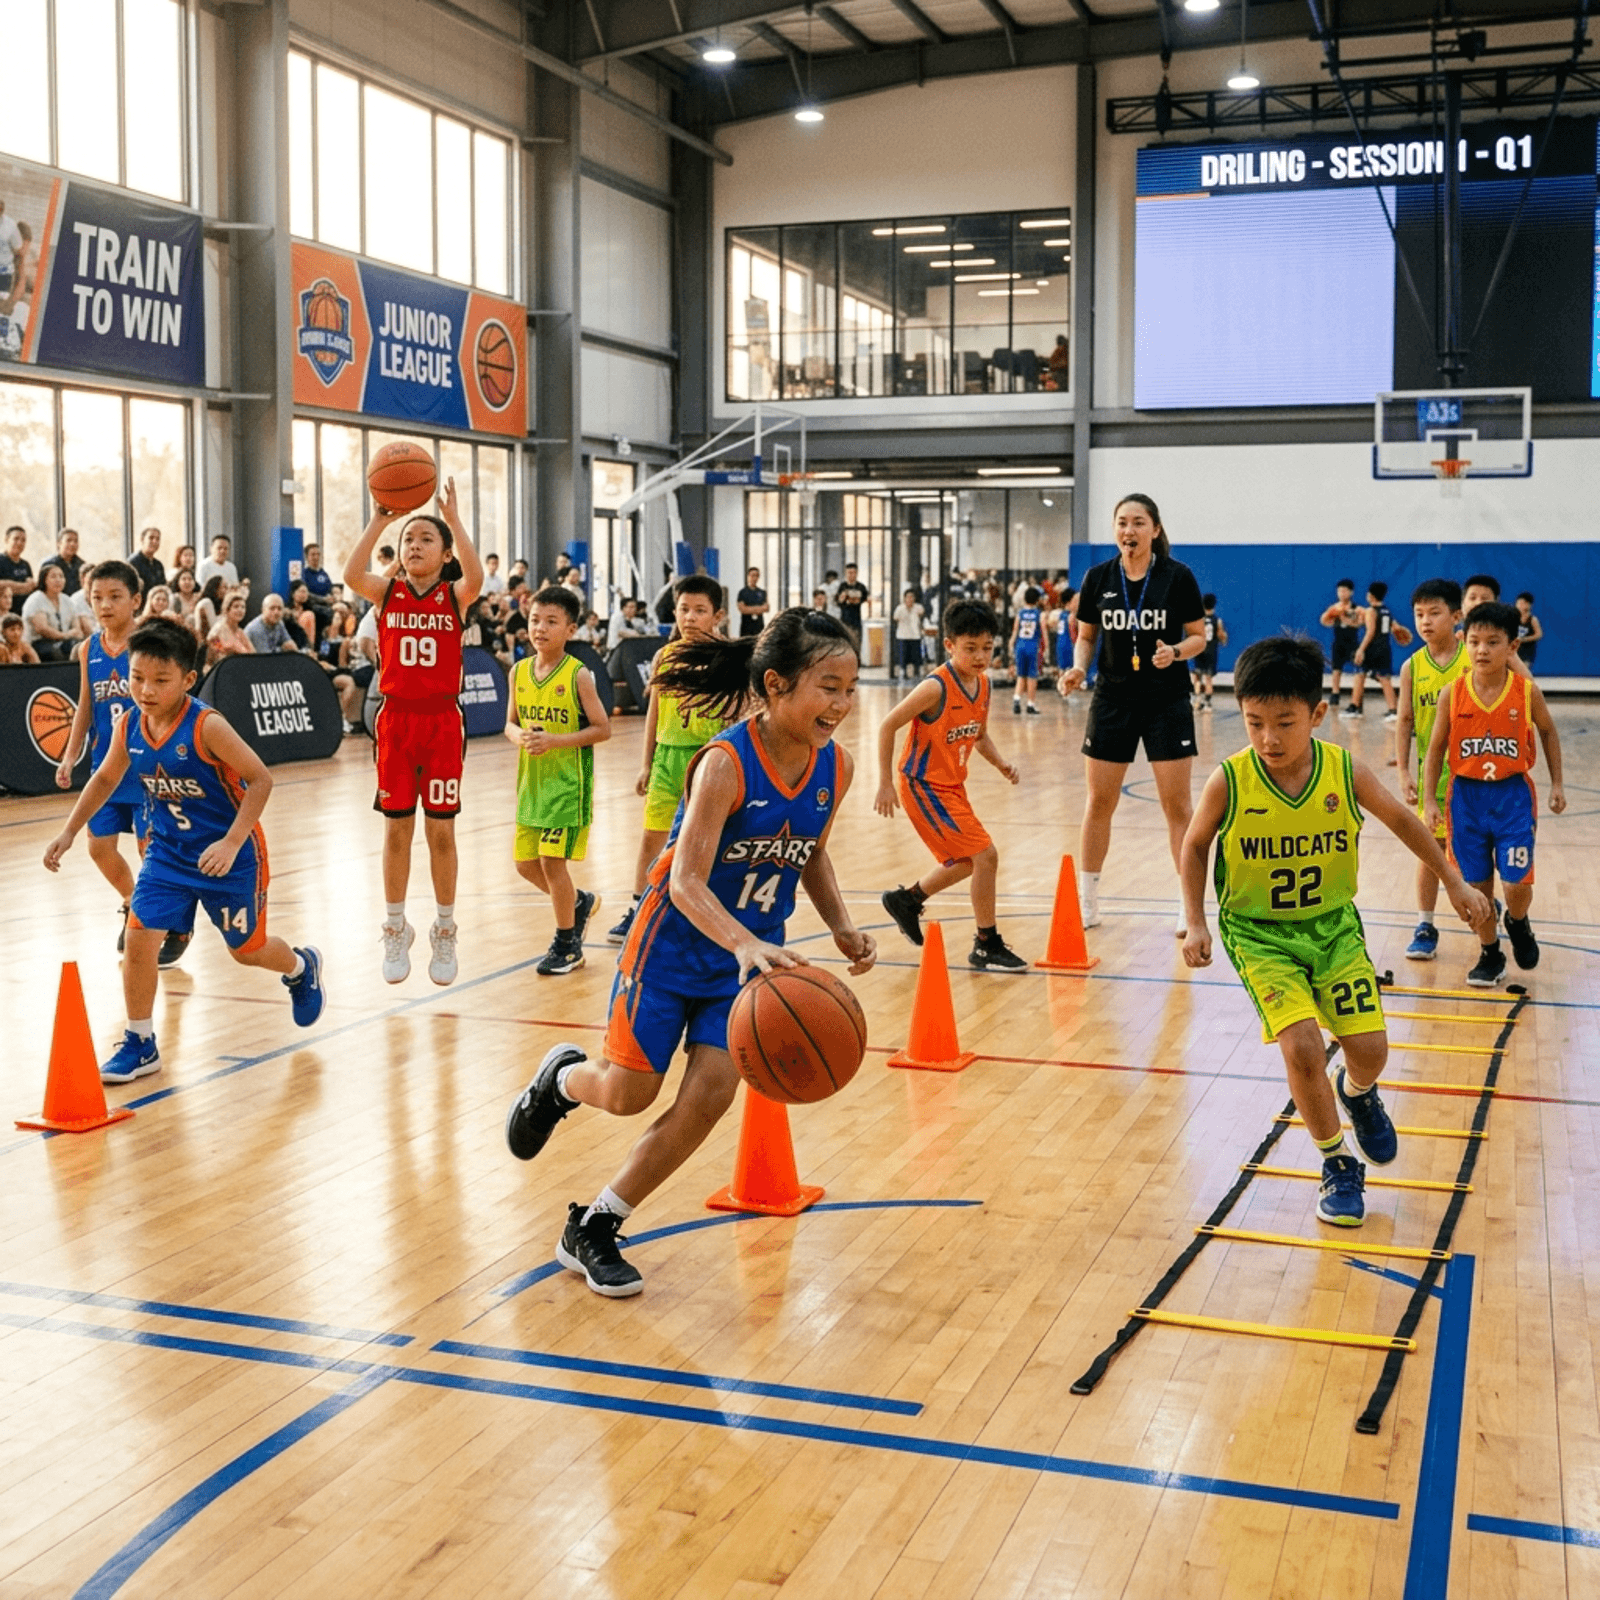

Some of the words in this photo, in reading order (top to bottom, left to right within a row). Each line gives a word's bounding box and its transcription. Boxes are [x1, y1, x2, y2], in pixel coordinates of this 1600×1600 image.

[1201, 150, 1306, 187] DRILING
[1329, 141, 1444, 179] SESSION
[1495, 134, 1533, 171] Q1
[73, 221, 182, 297] TRAIN
[73, 283, 114, 336] TO
[122, 293, 183, 347] WIN
[379, 301, 452, 350] JUNIOR
[379, 341, 453, 388] LEAGUE
[386, 612, 454, 631] WILDCATS
[1101, 608, 1167, 631] COACH
[399, 635, 438, 668] 09
[250, 680, 307, 710] JUNIOR
[254, 706, 314, 737] LEAGUE
[1460, 737, 1518, 759] STARS
[428, 778, 459, 805] 09
[167, 802, 191, 831] 5
[724, 838, 817, 866] STARS
[1240, 829, 1349, 860] WILDCATS
[1506, 846, 1530, 868] 19
[735, 872, 782, 913] 14
[1270, 865, 1323, 910] 22
[220, 906, 249, 935] 14
[1331, 977, 1377, 1017] 22
